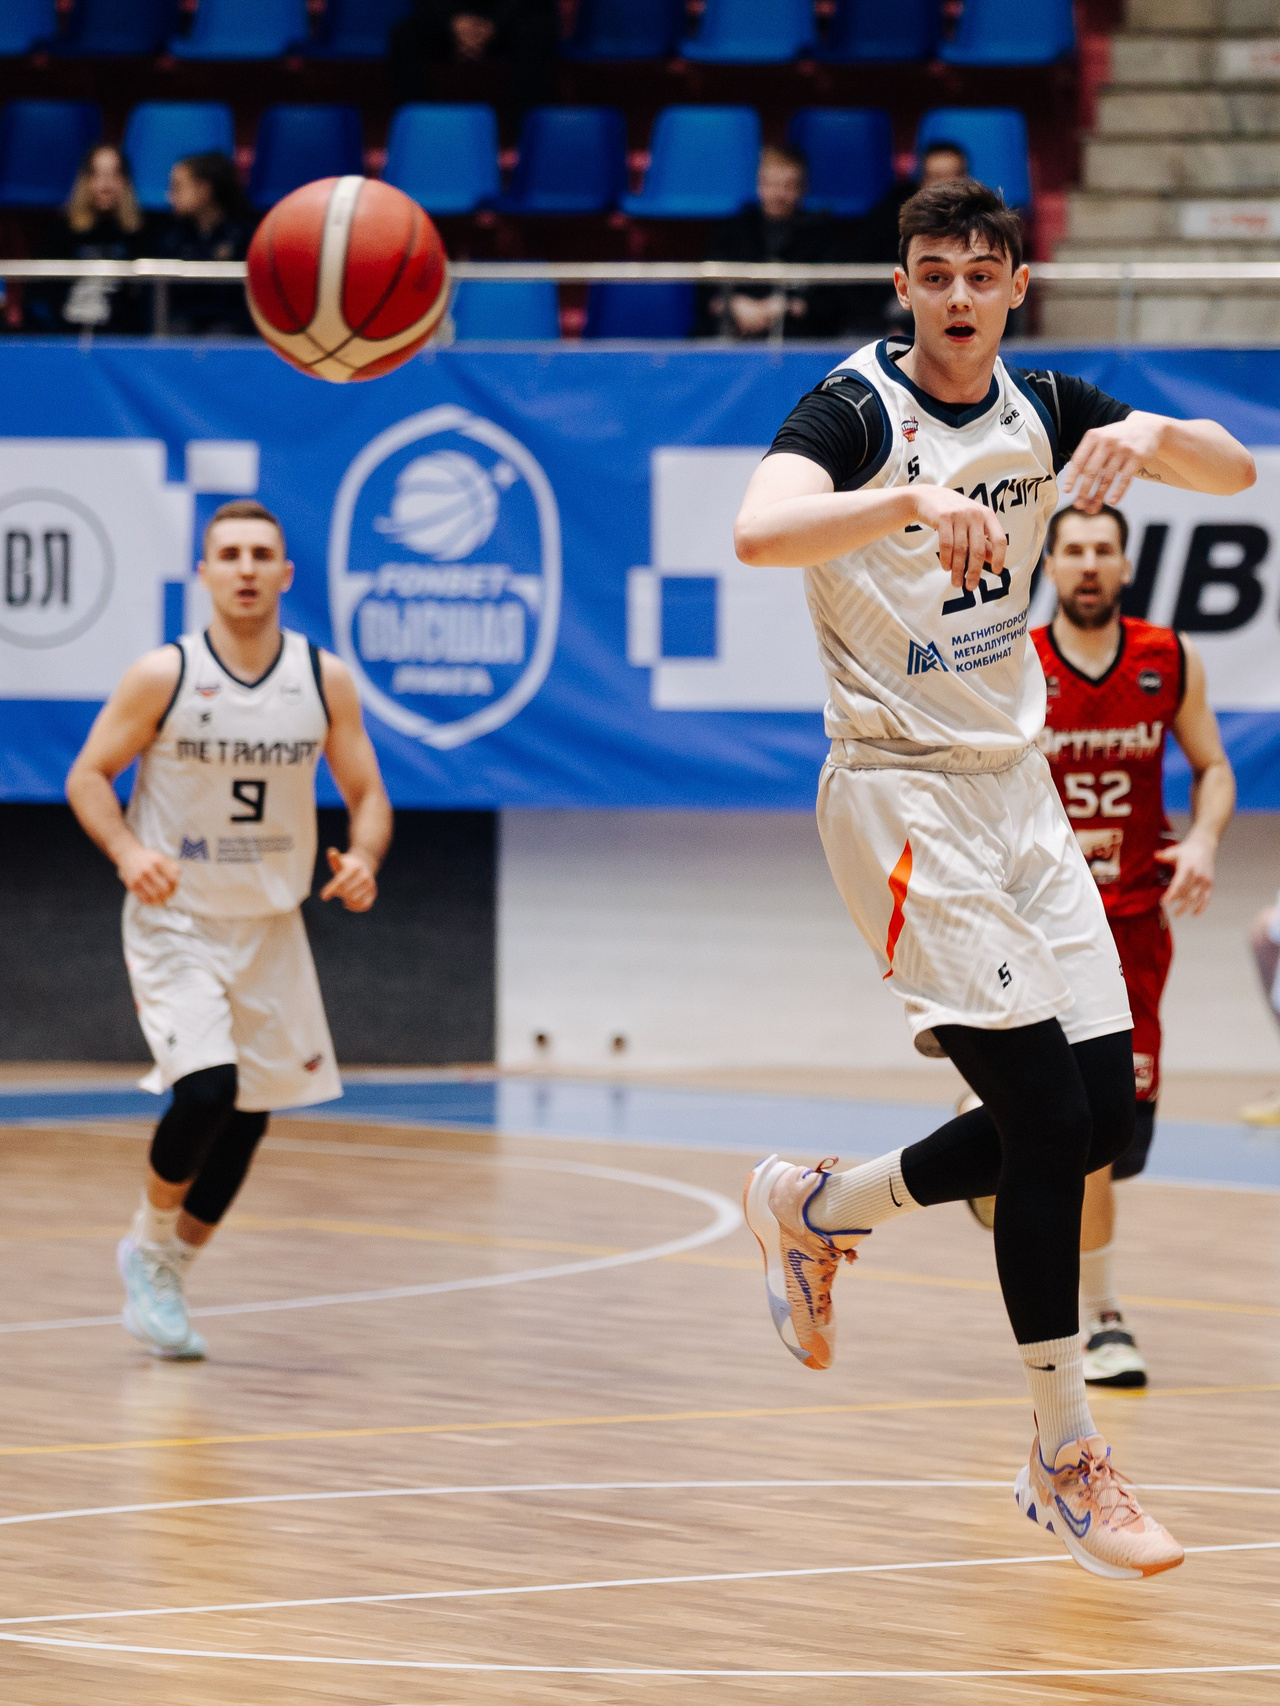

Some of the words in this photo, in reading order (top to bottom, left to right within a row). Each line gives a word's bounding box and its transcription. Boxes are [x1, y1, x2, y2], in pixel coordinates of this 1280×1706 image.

[1000, 409, 1020, 426] ФБ
[956, 647, 1012, 673] КОМБИНАТ
[231, 780, 266, 823] 9
[1064, 770, 1132, 819] 52
